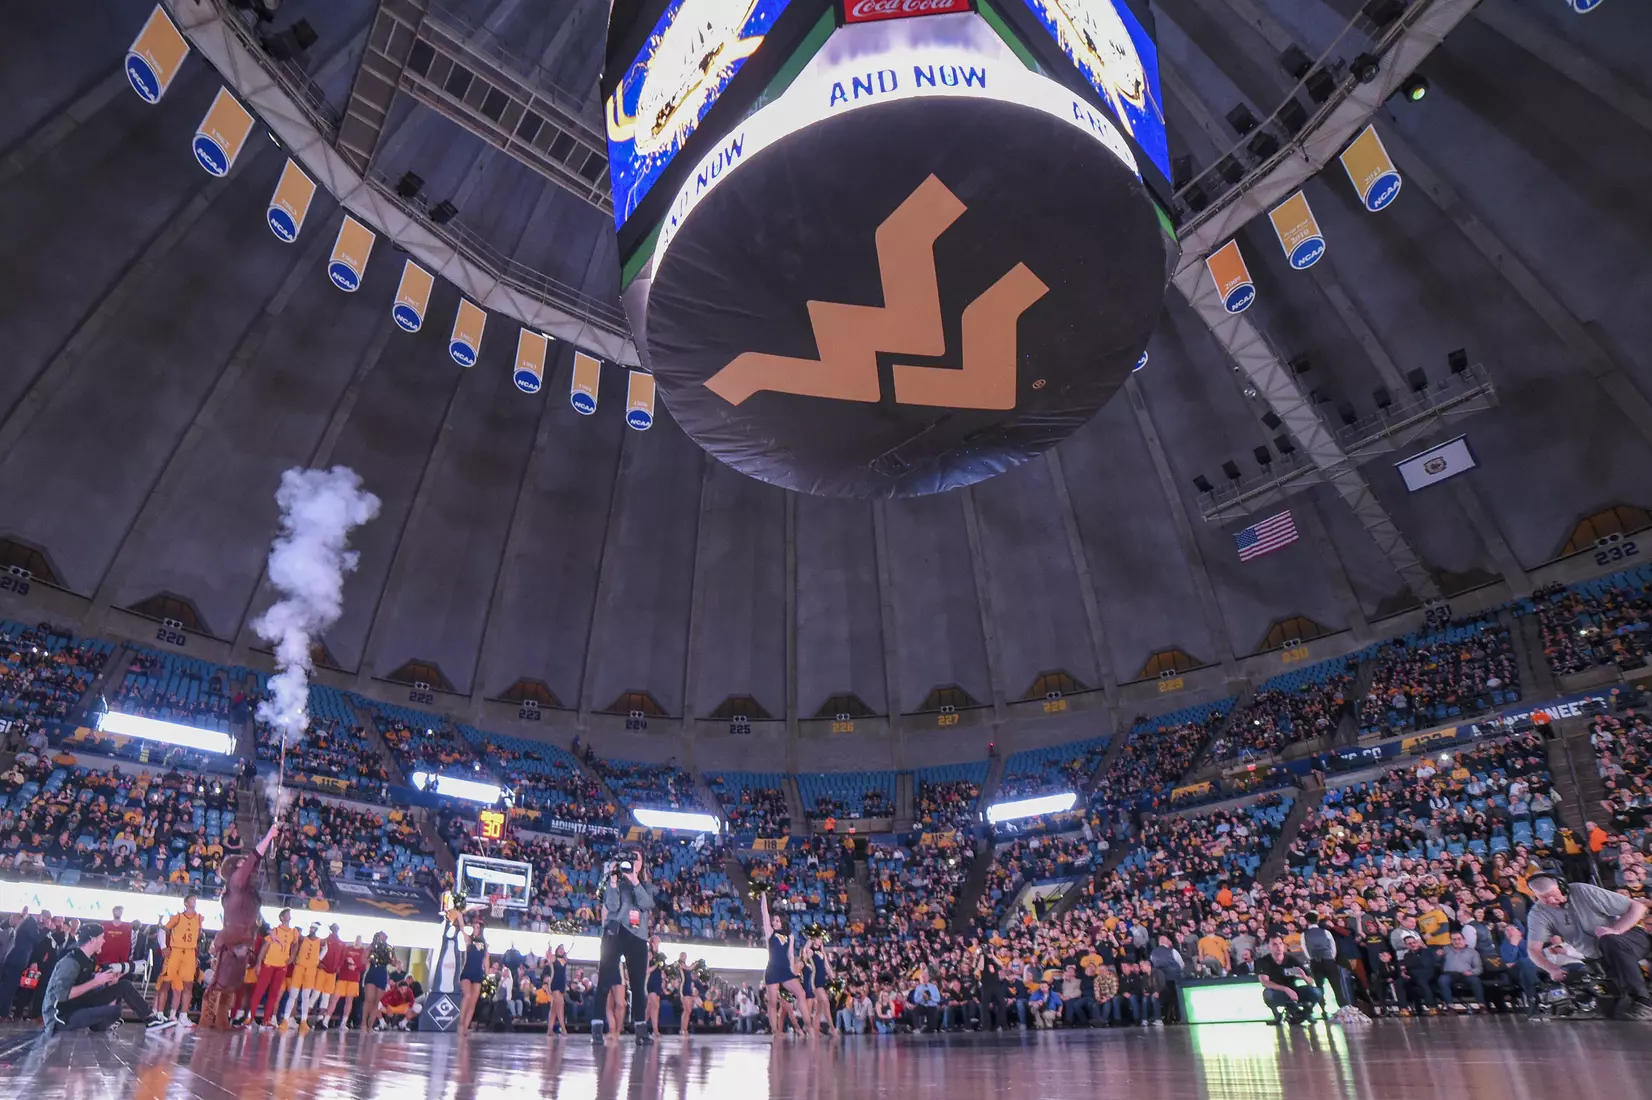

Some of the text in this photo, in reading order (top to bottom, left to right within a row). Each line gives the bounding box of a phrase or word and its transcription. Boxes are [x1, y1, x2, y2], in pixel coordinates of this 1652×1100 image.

[129, 67, 155, 101] NCAA
[830, 65, 986, 107] AND NOW
[197, 147, 224, 175] NCAA
[696, 132, 744, 195] NOW
[1374, 180, 1400, 207] NCAA
[271, 217, 293, 241] NCAA
[1298, 246, 1323, 266] NCAA
[332, 271, 356, 290] NCAA
[1231, 291, 1254, 311] NCAA
[396, 313, 418, 330] NCAA
[453, 350, 474, 365] NCAA
[517, 379, 539, 391] NCAA
[574, 401, 594, 412] NCAA
[630, 418, 651, 427] NCAA
[1594, 541, 1640, 567] 232
[1, 575, 30, 596] 219
[156, 628, 186, 647] 220
[1282, 647, 1309, 663] 230
[1158, 678, 1184, 692] 229
[409, 690, 434, 705] 222
[519, 708, 541, 721] 223
[1043, 700, 1067, 713] 228
[625, 719, 648, 731] 224
[832, 721, 854, 733] 226
[938, 714, 960, 727] 227
[729, 723, 751, 735] 225
[482, 820, 500, 838] 30
[763, 839, 778, 850] 118
[183, 933, 192, 943] 45
